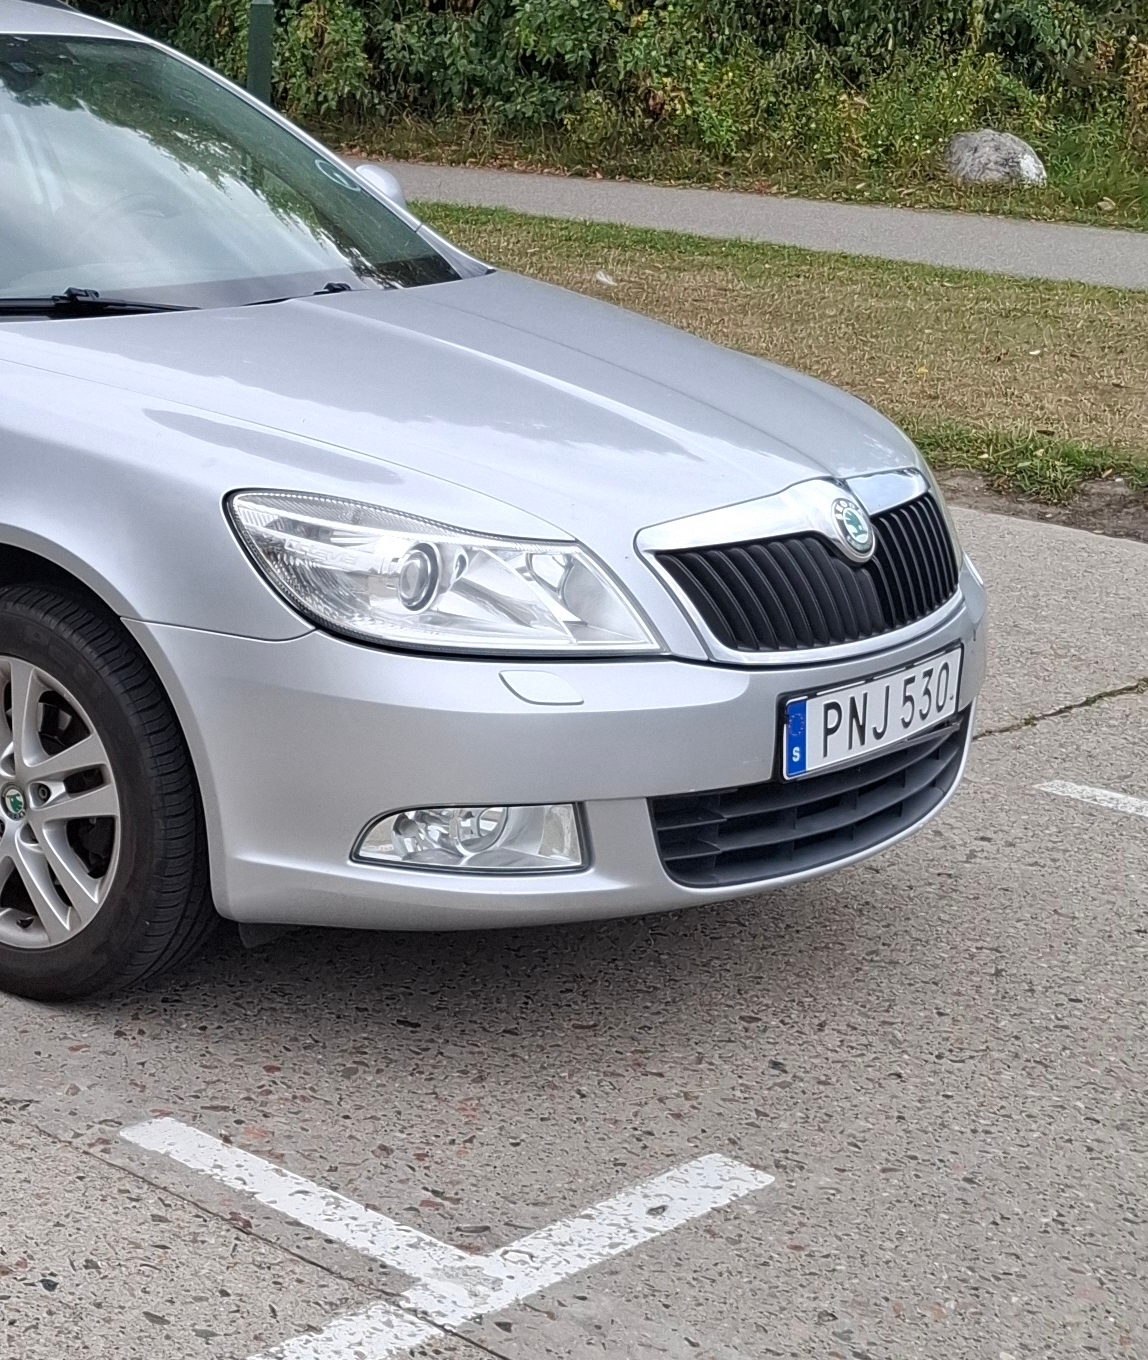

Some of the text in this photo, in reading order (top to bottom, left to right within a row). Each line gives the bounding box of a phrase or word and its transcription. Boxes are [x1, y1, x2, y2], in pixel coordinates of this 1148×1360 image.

[823, 662, 950, 758] PNJ 530
[792, 747, 800, 762] S
